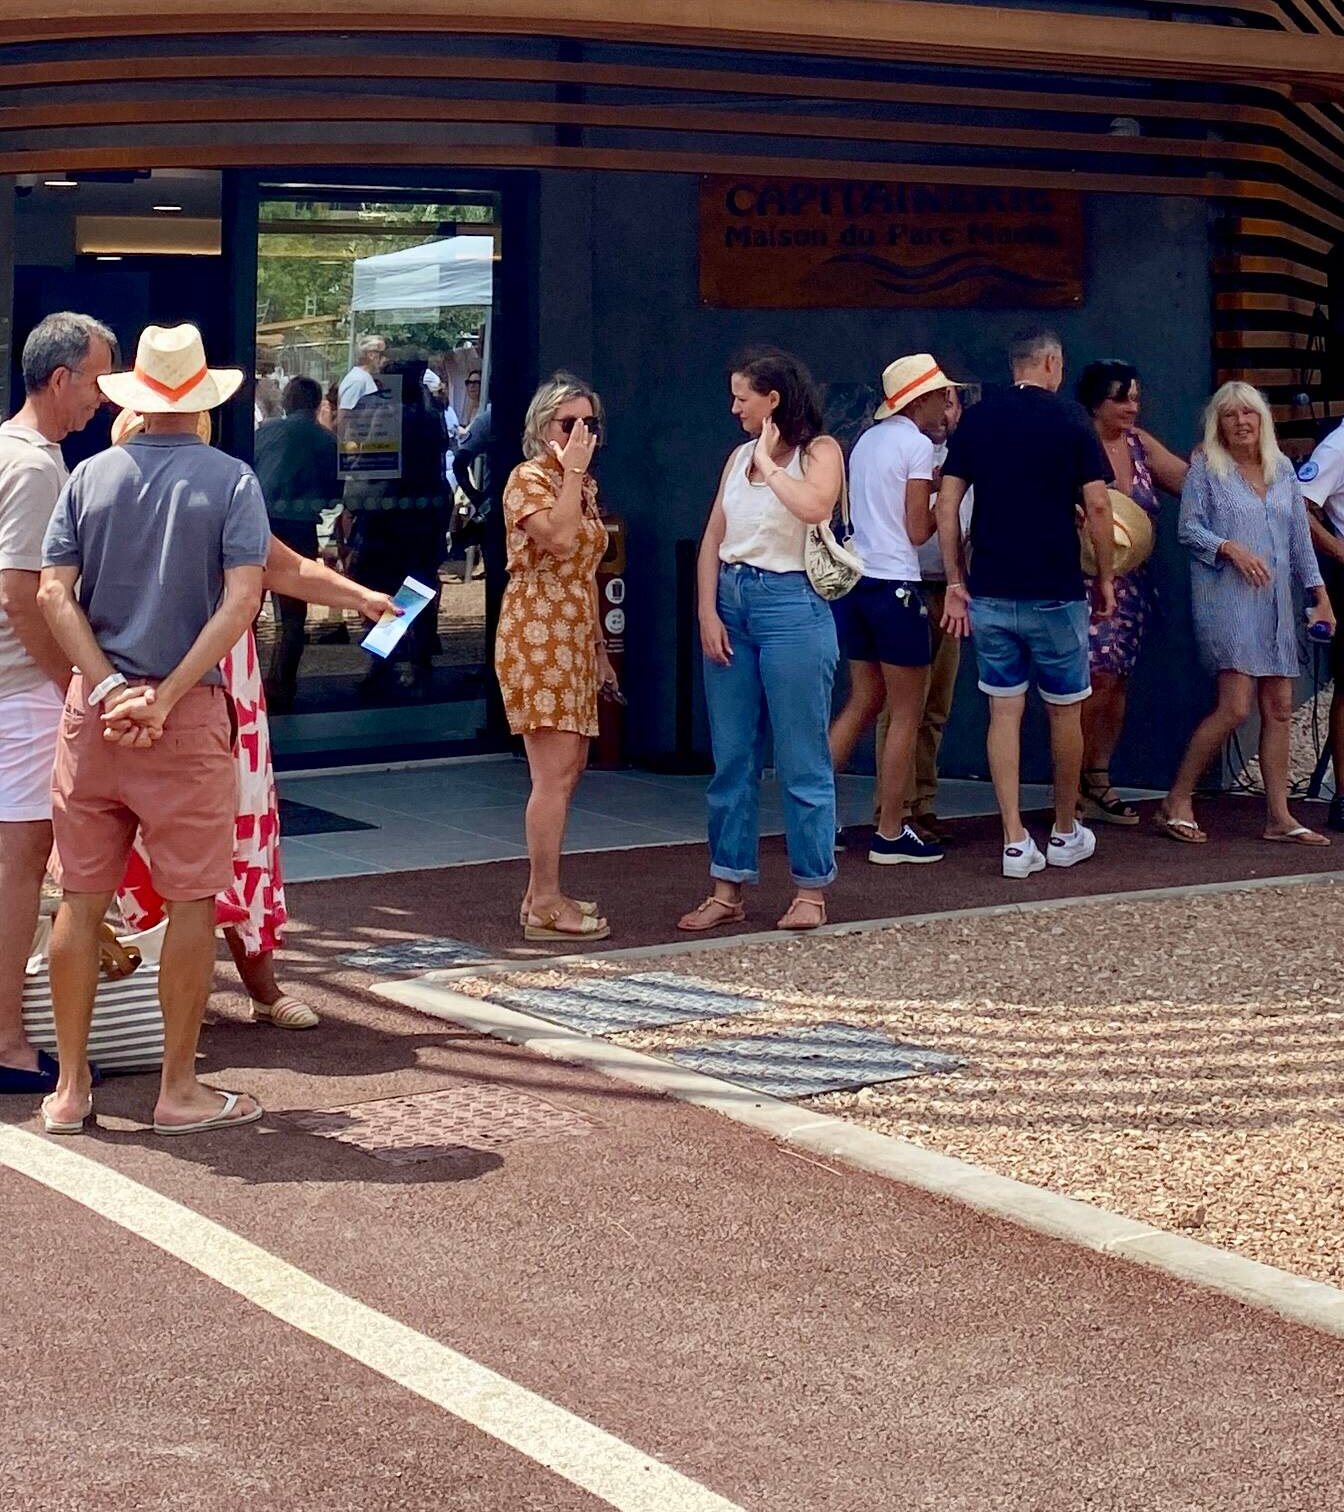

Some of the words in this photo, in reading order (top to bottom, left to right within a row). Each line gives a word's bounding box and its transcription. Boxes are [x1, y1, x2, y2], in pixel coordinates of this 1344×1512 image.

[724, 183, 1056, 217] CAPITAINERIE
[724, 225, 829, 248] Maison
[840, 223, 877, 247] du
[887, 223, 960, 247] Parc
